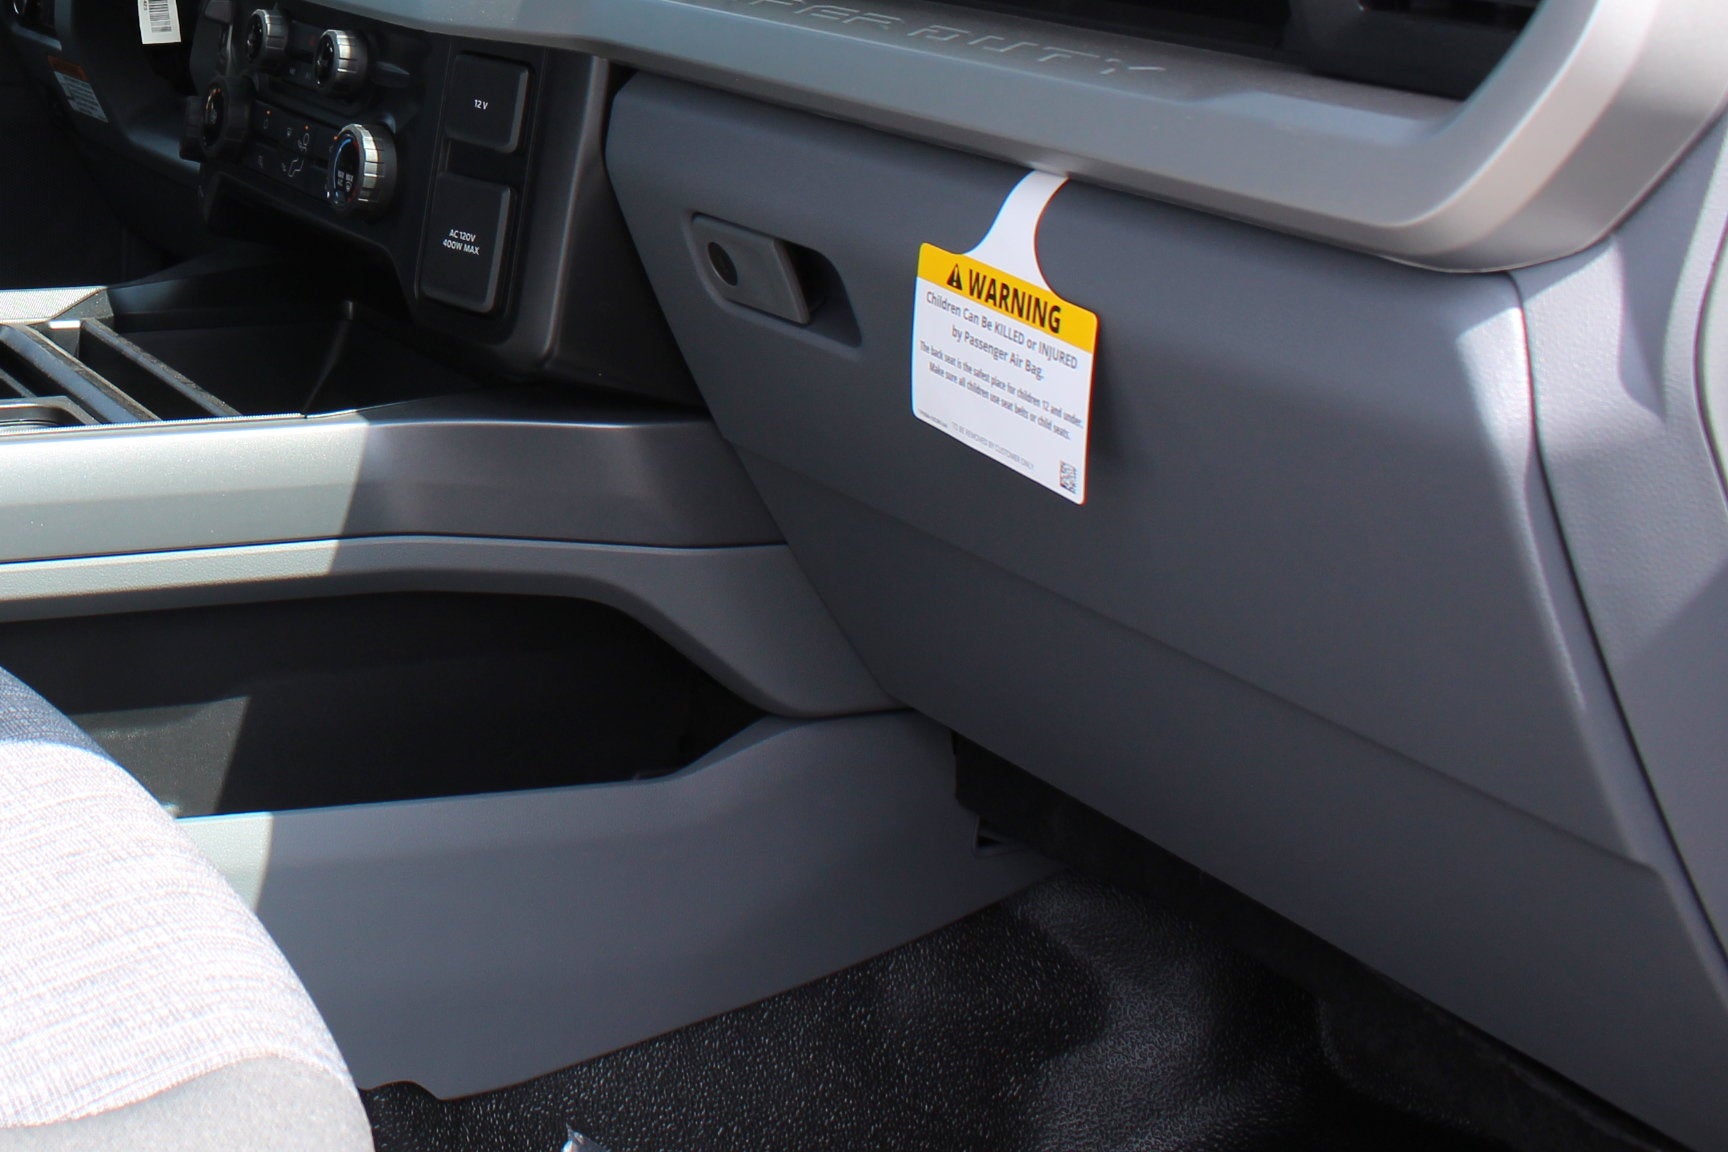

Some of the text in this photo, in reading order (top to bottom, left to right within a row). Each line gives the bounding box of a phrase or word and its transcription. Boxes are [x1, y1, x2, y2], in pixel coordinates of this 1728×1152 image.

[907, 24, 1167, 75] DUTY
[442, 239, 480, 256] 400W MAX
[449, 229, 476, 242] AC 120V
[926, 291, 1078, 369] Children Can Be KILLED or INJURED
[968, 268, 1062, 334] WARNING
[952, 325, 963, 343] by
[964, 331, 1009, 361] Passenger
[1010, 351, 1024, 367] Air
[920, 340, 930, 353] The
[930, 345, 943, 360] back
[944, 353, 956, 366] seat
[963, 361, 972, 374] the
[973, 367, 990, 383] safest
[991, 375, 1006, 391] place
[1007, 382, 1015, 395] for
[1017, 387, 1041, 407] children
[1042, 399, 1050, 411] 12
[1050, 403, 1062, 418] and
[929, 361, 944, 377] Make
[945, 370, 957, 383] sure
[958, 376, 966, 387] all
[967, 381, 989, 399] children
[990, 393, 1000, 405] use
[1001, 398, 1013, 411] seat
[1014, 404, 1028, 419] belts
[1029, 412, 1037, 423] or
[1037, 414, 1052, 432] child
